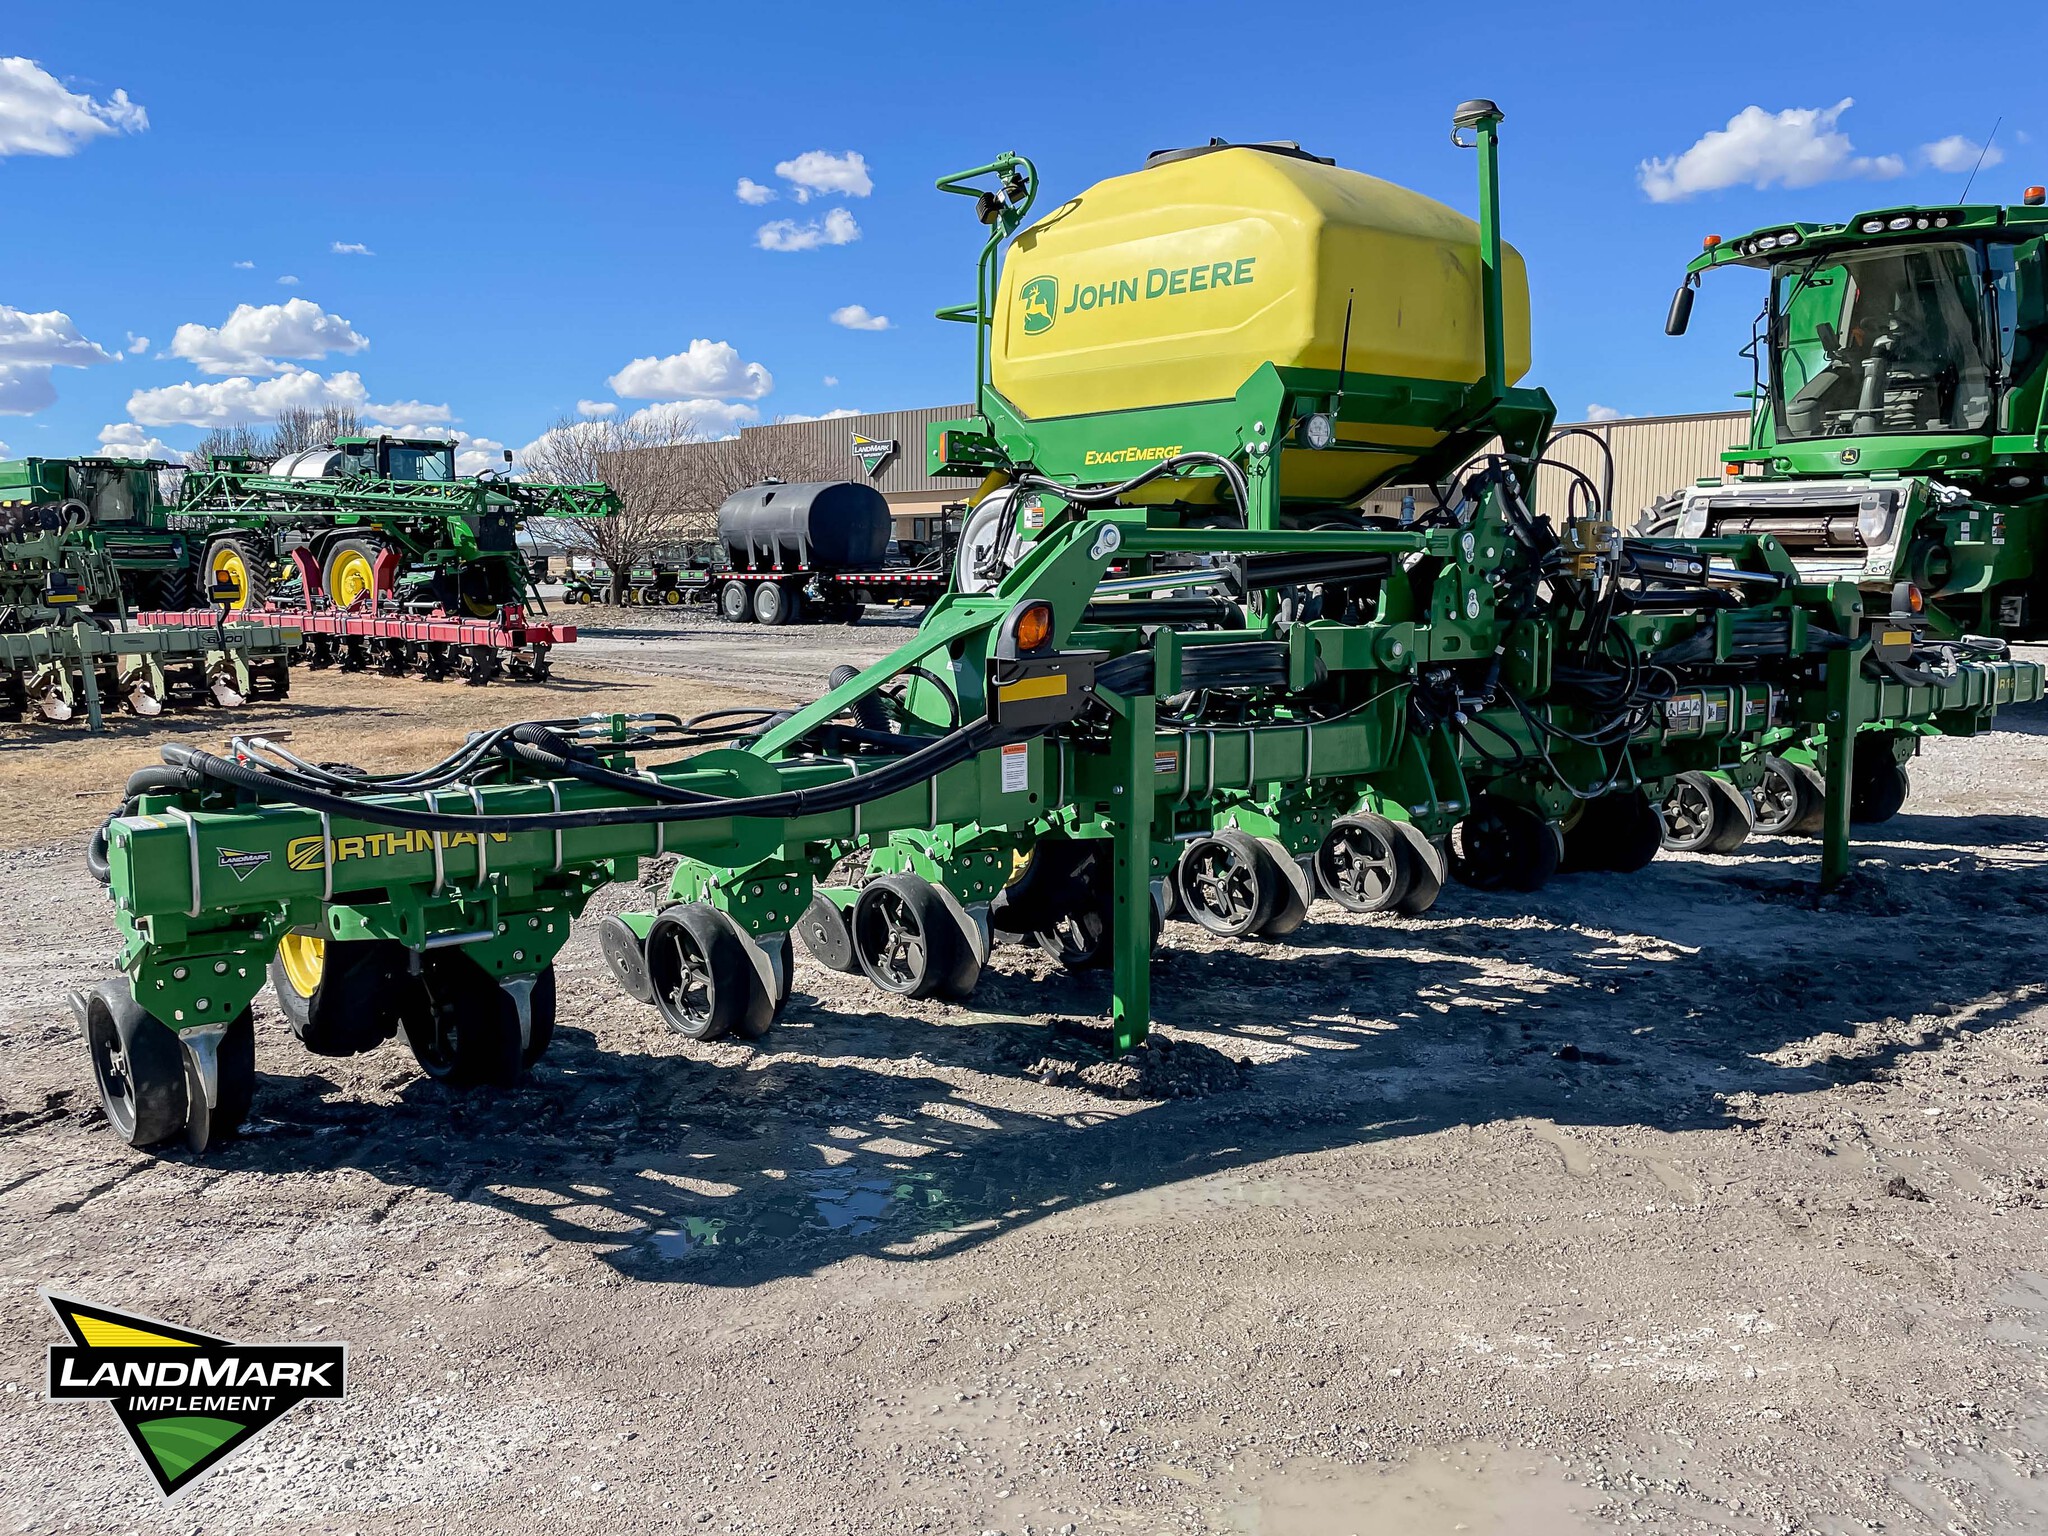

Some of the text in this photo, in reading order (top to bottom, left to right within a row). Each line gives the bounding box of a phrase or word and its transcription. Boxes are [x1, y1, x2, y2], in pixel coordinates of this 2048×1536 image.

[1064, 257, 1256, 314] JOHN DEERE
[1084, 445, 1183, 465] EXACTEMERGE
